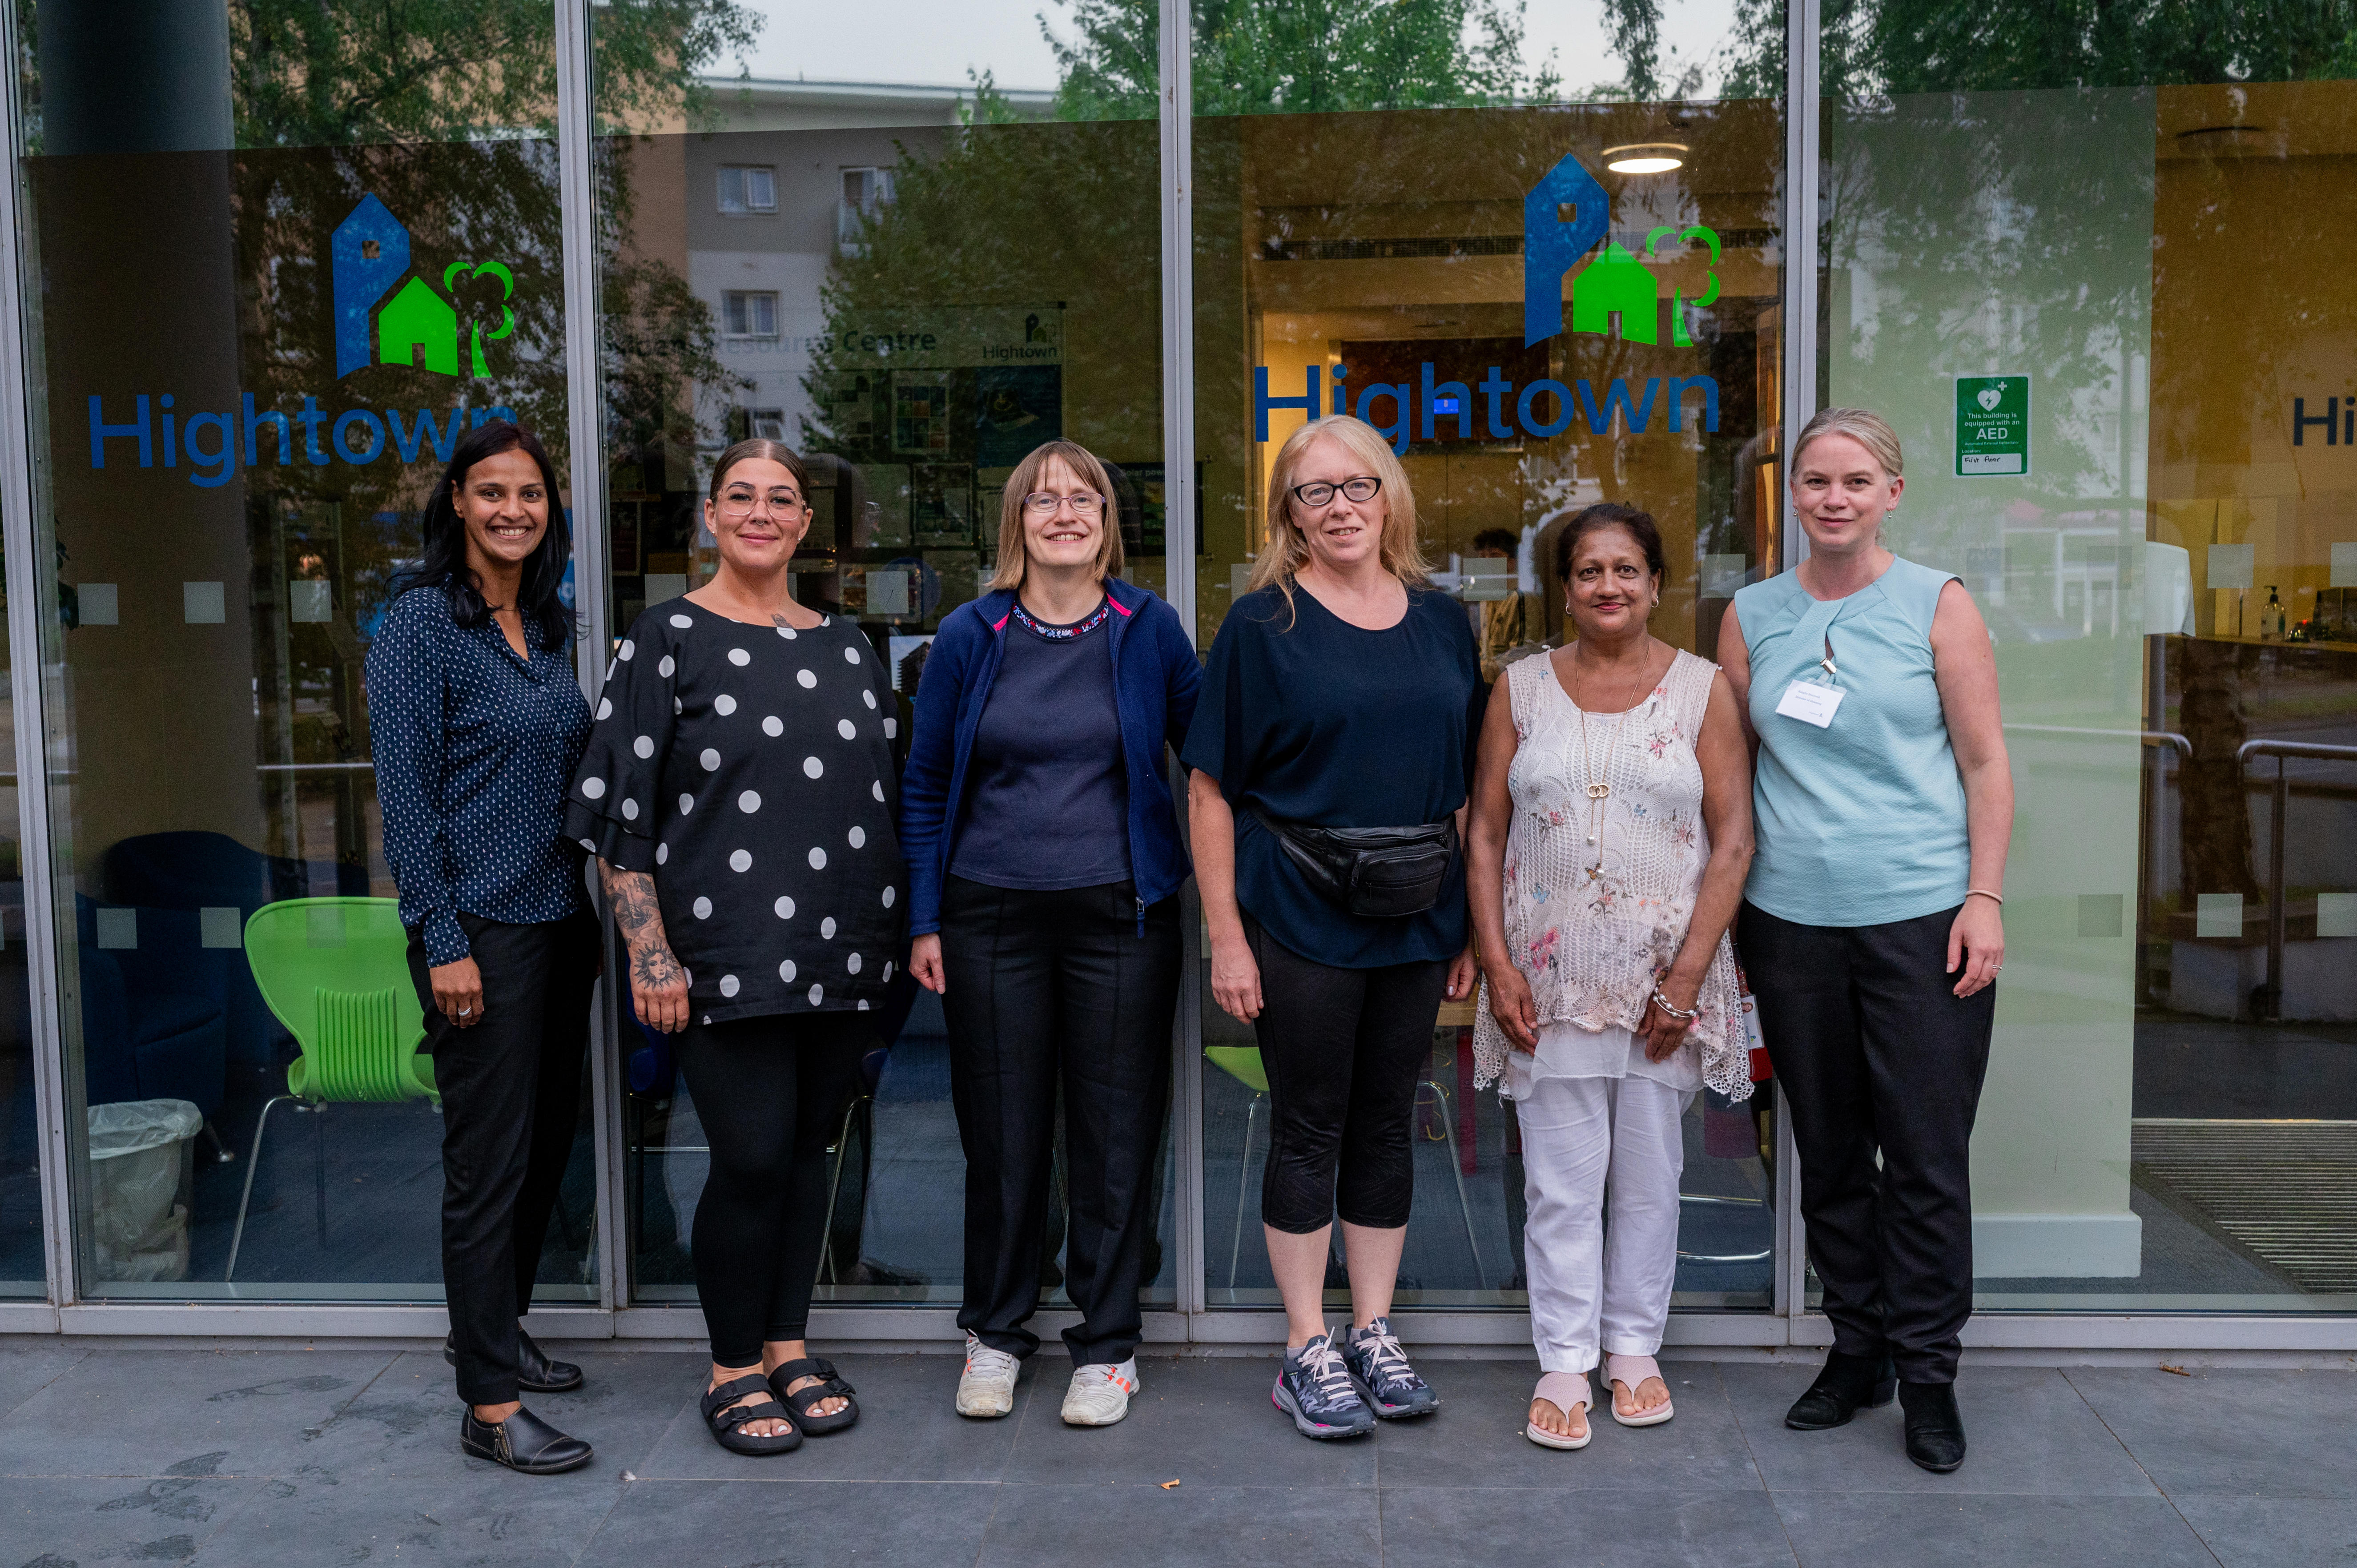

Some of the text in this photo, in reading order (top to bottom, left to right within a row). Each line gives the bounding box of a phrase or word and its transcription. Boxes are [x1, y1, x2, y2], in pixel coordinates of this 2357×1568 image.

[843, 330, 937, 352] Centre
[982, 345, 1057, 362] Hightown
[1254, 362, 1720, 458] Hightown
[1983, 412, 2010, 420] building
[1976, 428, 2008, 440] AED
